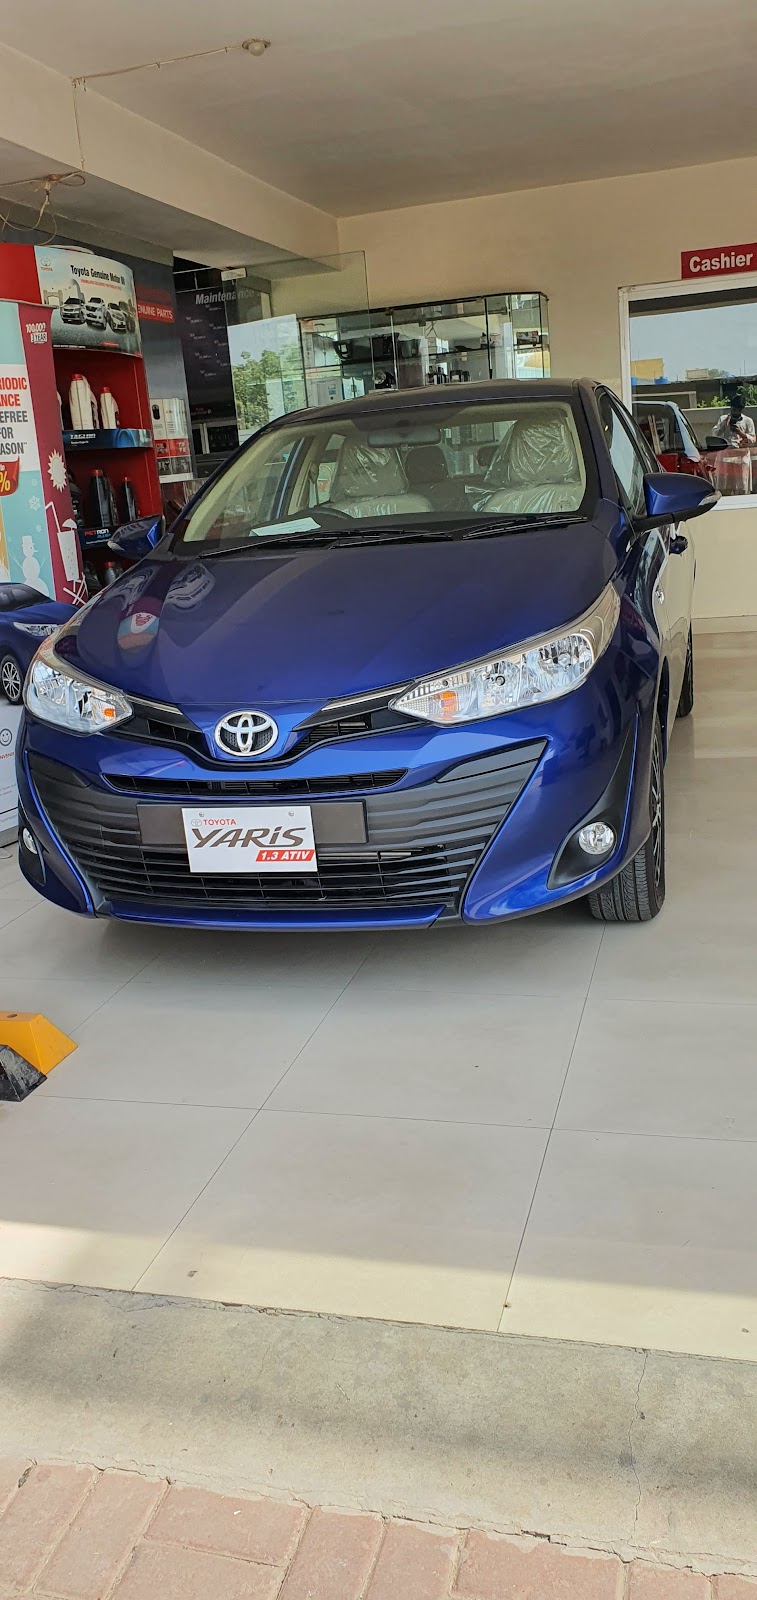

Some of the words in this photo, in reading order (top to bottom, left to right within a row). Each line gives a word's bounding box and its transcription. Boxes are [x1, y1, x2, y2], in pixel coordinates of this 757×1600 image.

[689, 251, 754, 273] Cashier
[70, 264, 90, 277] Toyota
[90, 268, 110, 281] Genuine
[109, 272, 121, 284] Motor
[156, 307, 174, 320] PARTS
[34, 333, 47, 342] YEAR
[0, 377, 28, 391] IODIC
[0, 426, 14, 440] OR
[203, 818, 237, 826] TOYOTA
[261, 851, 279, 861] 1.3
[280, 850, 310, 861] ATIV
